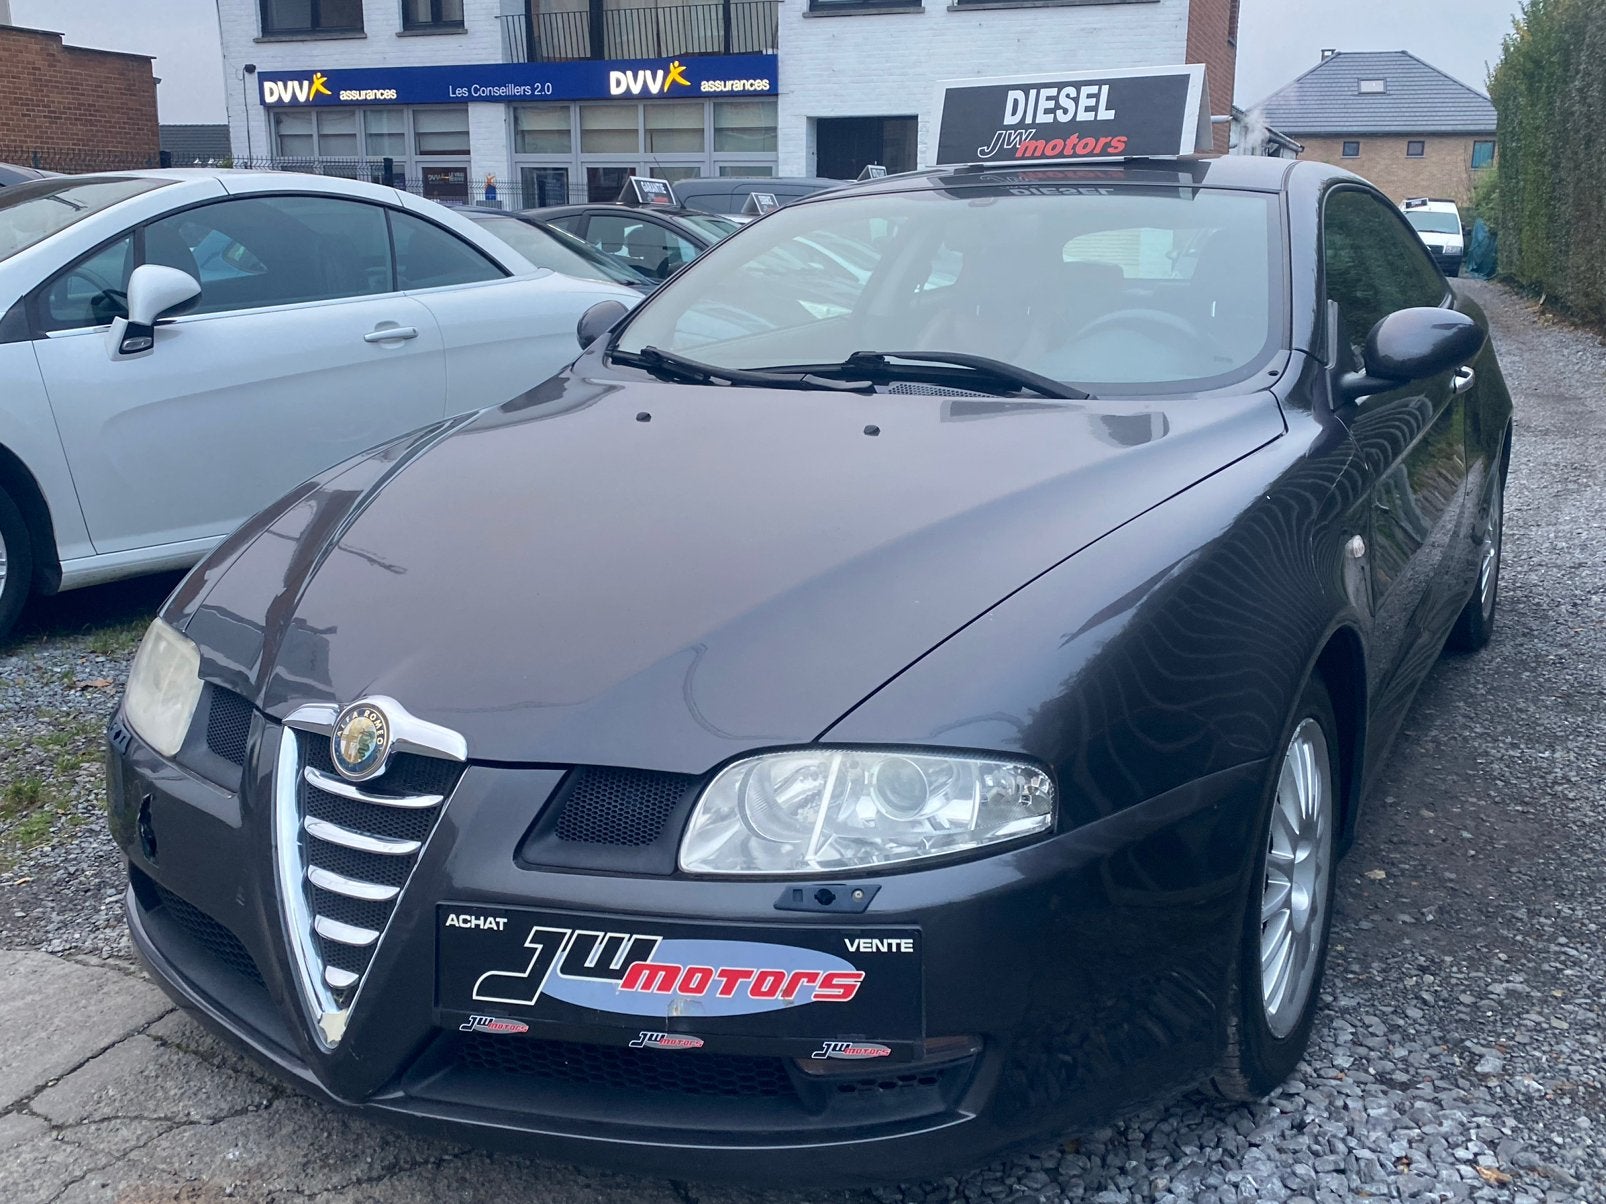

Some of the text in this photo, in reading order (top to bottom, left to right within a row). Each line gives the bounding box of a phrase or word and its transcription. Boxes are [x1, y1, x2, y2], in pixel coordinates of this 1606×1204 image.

[263, 80, 397, 103] DVV assurances
[449, 82, 552, 97] Les Conseillers 2.0
[609, 70, 769, 95] DVV assurances
[1003, 84, 1116, 125] DIESEL
[977, 129, 1128, 159] JW motors
[337, 709, 384, 745] ALFA ROMEO
[445, 913, 507, 931] ACHAT
[844, 938, 914, 953] VENTE
[472, 926, 663, 1006] JW
